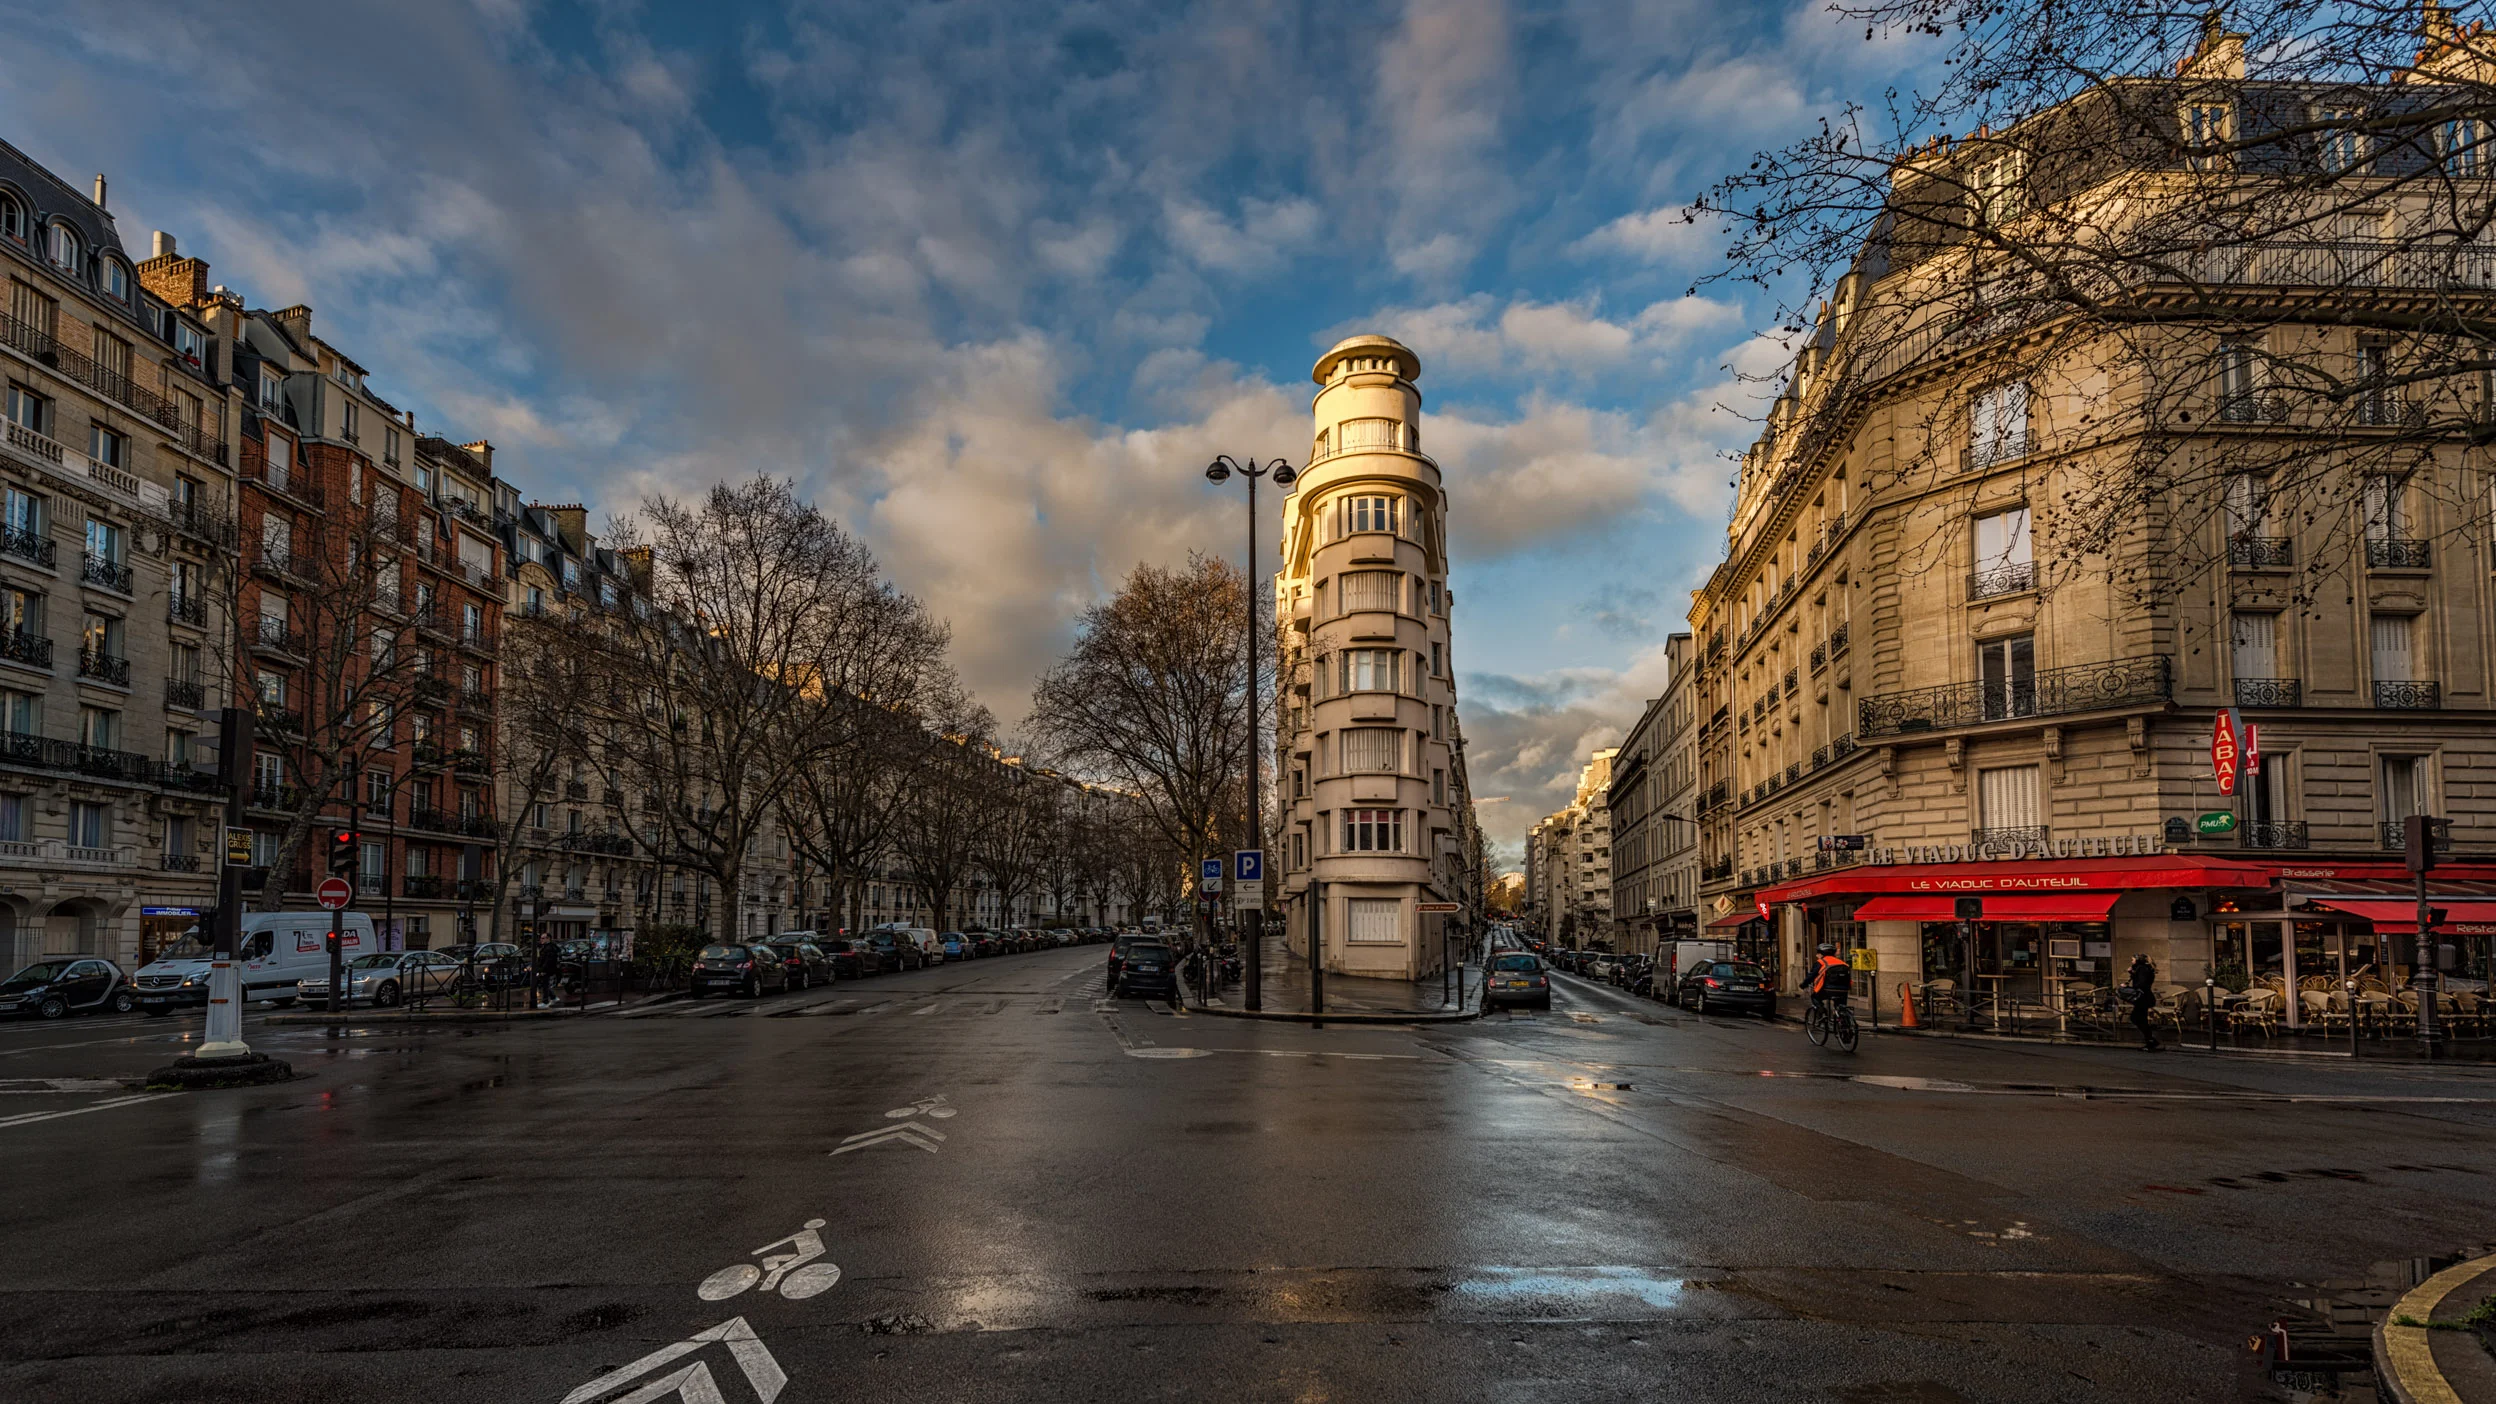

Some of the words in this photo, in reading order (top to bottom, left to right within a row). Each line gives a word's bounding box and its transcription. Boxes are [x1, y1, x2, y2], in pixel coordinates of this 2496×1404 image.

[2215, 713, 2234, 790] TABAC
[2200, 820, 2218, 828] PMU
[228, 832, 251, 842] ALEXIS
[228, 840, 251, 849] GRUSS
[1868, 847, 1893, 865] LE
[1903, 842, 1996, 864] VIADUC
[2009, 834, 2162, 860] D'AUTEUIL
[1243, 856, 1255, 876] P
[2282, 868, 2335, 877] Brasserie
[1911, 881, 1930, 889] LE
[1935, 879, 1994, 889] VIADUC
[2000, 877, 2089, 888] D'AUTEUIL
[2456, 924, 2496, 933] Resta
[342, 930, 356, 938] DA
